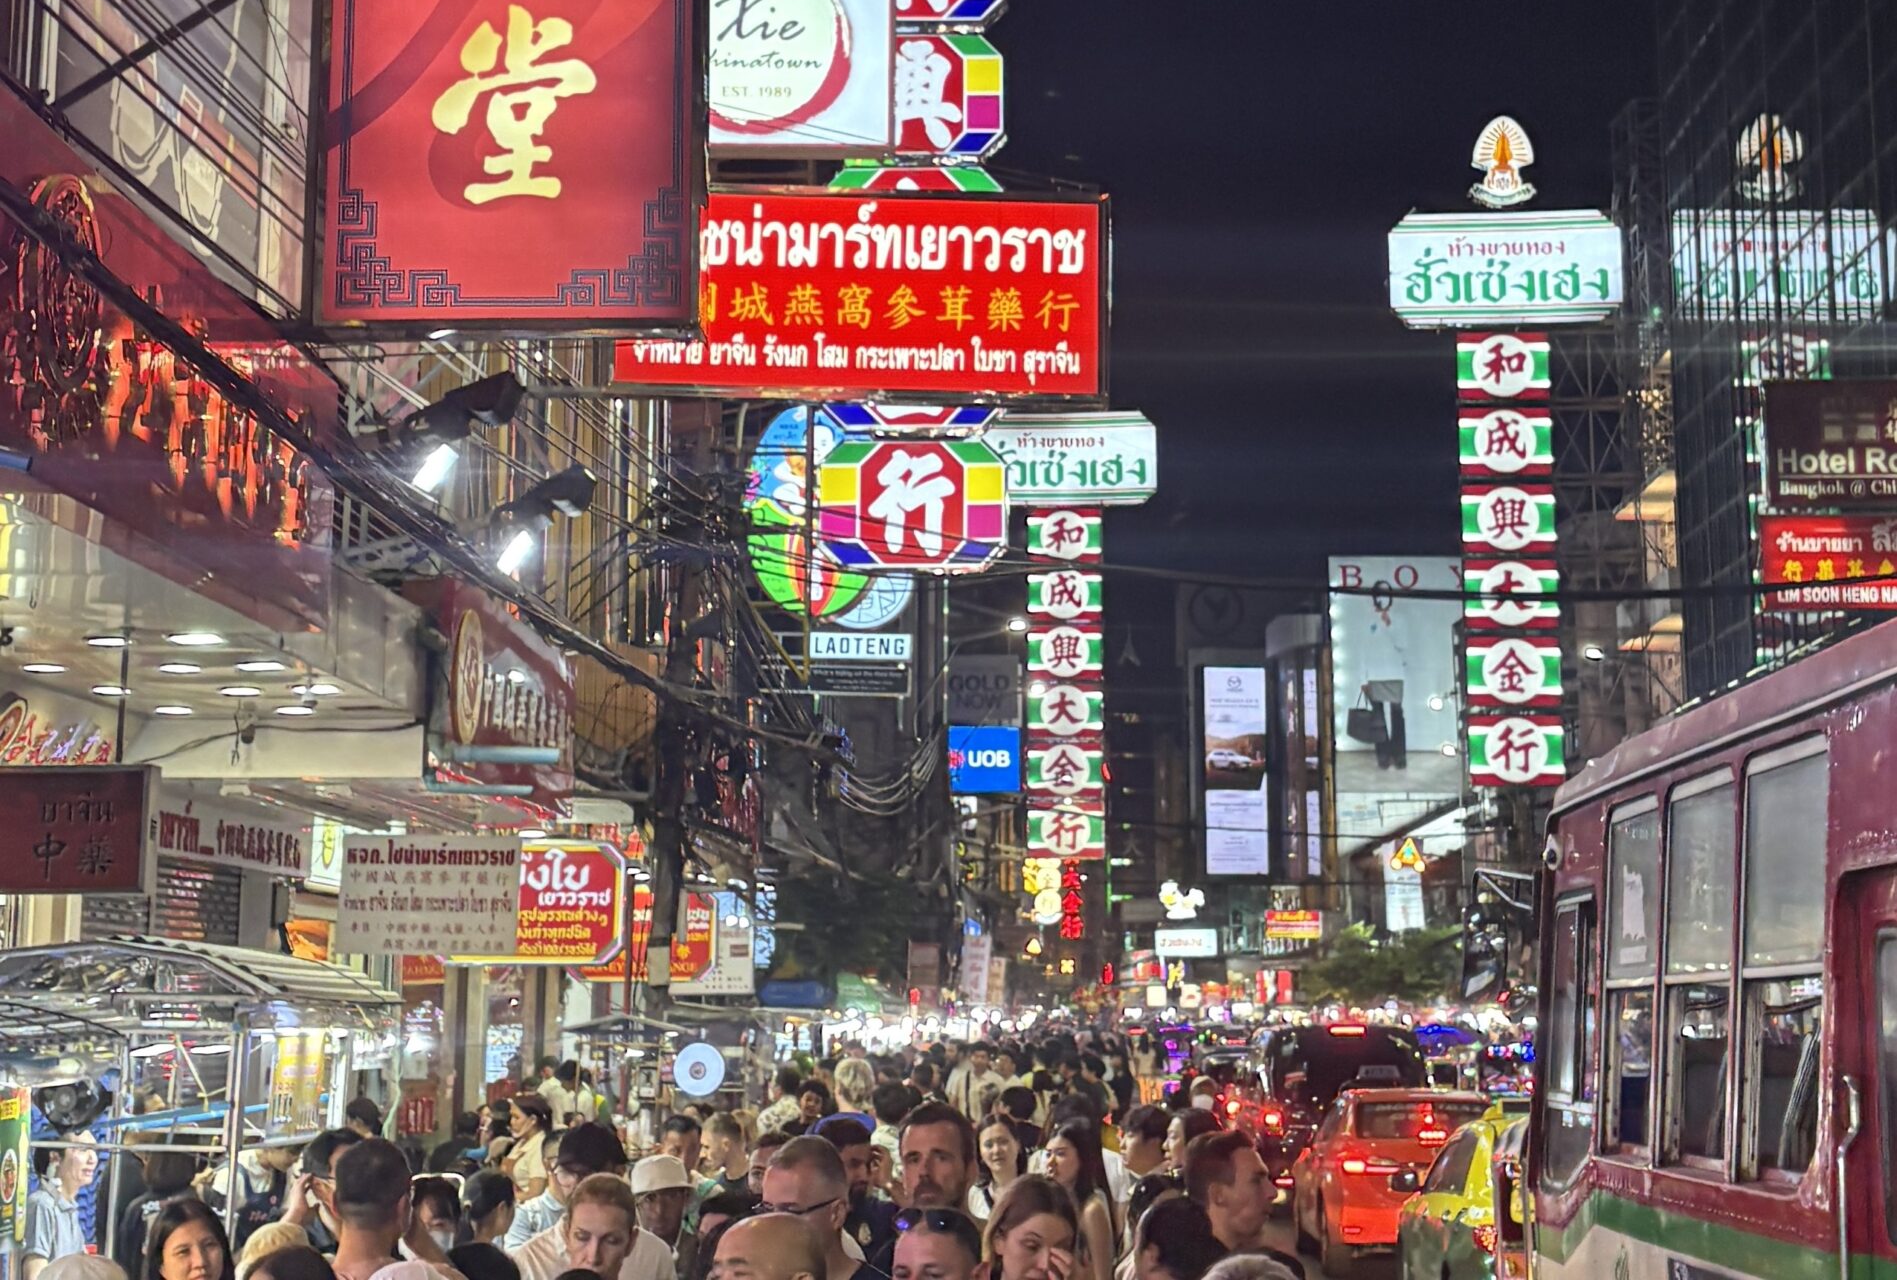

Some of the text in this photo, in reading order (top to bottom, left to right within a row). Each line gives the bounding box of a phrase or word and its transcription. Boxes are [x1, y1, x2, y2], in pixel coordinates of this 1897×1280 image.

[710, 48, 822, 70] hinatown
[759, 86, 792, 98] 1989
[702, 201, 1085, 275] ชน่ามาร์ทเยาวราช
[1447, 235, 1566, 258] ห้างขายทอง
[1403, 246, 1611, 305] ฮั่วเซ่งเฮง
[1016, 432, 1105, 449] ห้างขายทอง
[998, 440, 1147, 487] ั่วเซ่งเฮง
[1777, 447, 1856, 474] Hotel
[1779, 479, 1845, 500] Bangkok
[1850, 479, 1866, 497] @
[868, 448, 957, 557] 行
[1481, 342, 1542, 775] 和成興大金行
[1777, 587, 1800, 603] LIM
[1802, 586, 1840, 603] SOON
[1842, 586, 1879, 603] HENG
[814, 636, 905, 657] LAOTENG
[950, 674, 1010, 692] GOLD
[1046, 516, 1089, 852] 和成興大金行
[967, 749, 1011, 768] UOB
